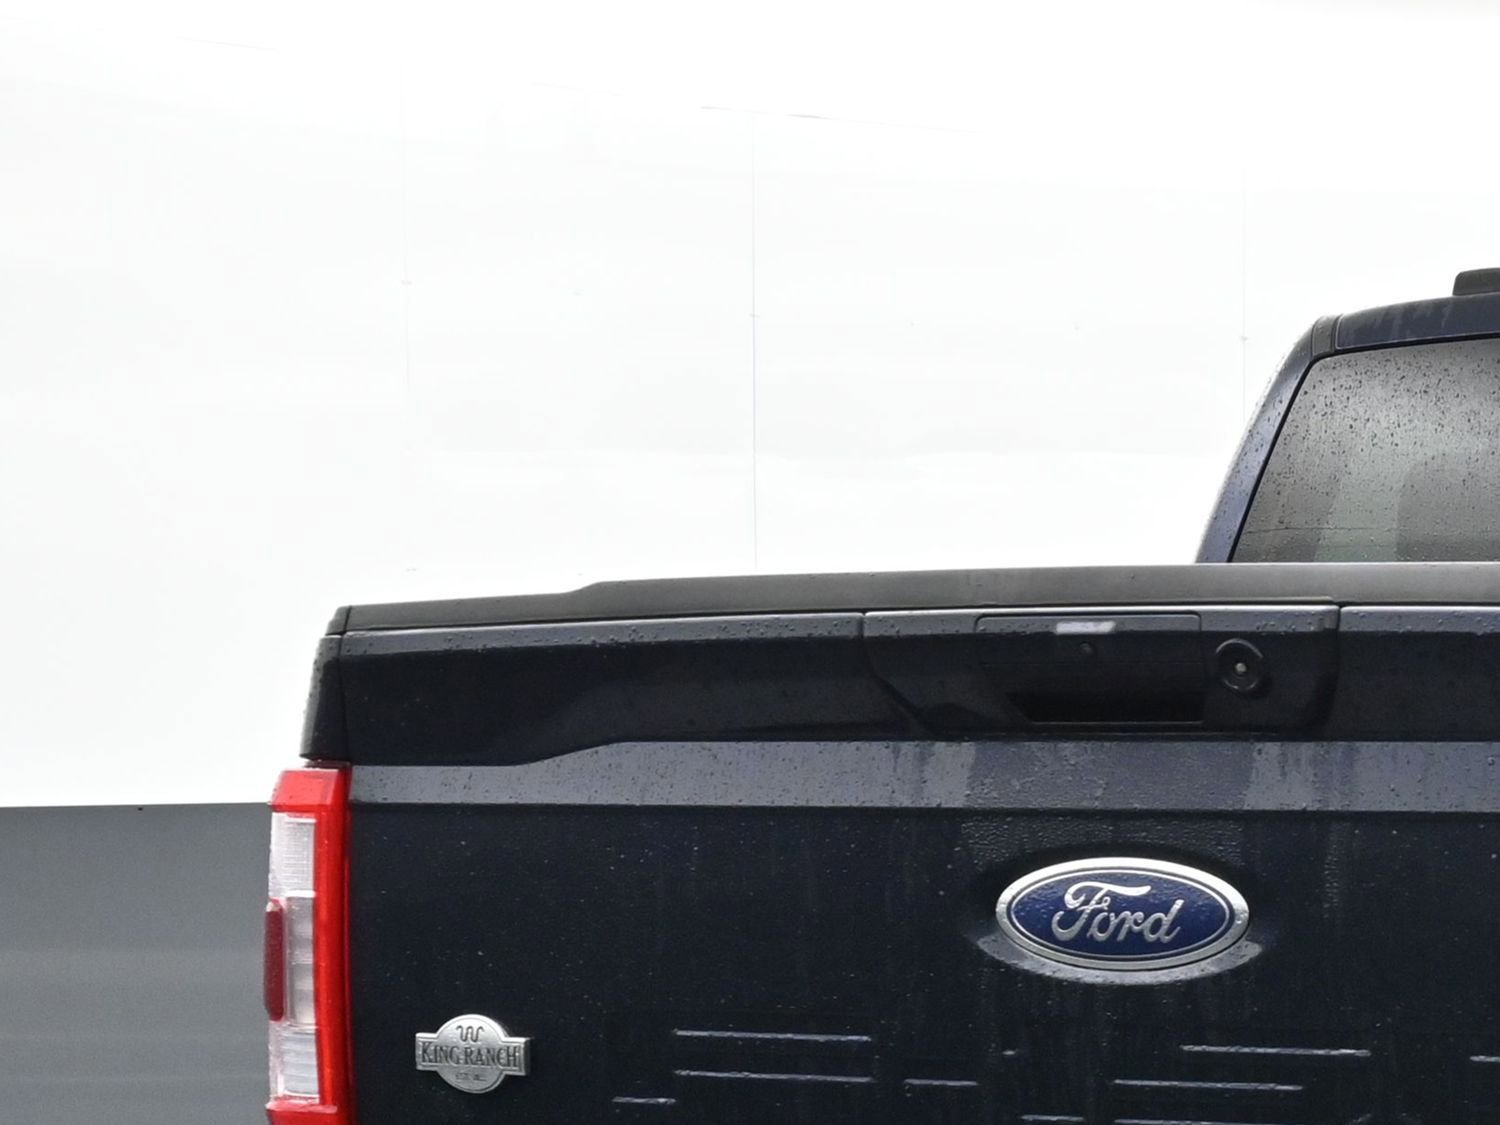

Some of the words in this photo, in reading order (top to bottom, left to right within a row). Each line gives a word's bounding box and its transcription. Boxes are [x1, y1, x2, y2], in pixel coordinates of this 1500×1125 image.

[1052, 881, 1184, 942] Ford
[422, 1042, 459, 1064] KING
[463, 1046, 518, 1067] RANCH
